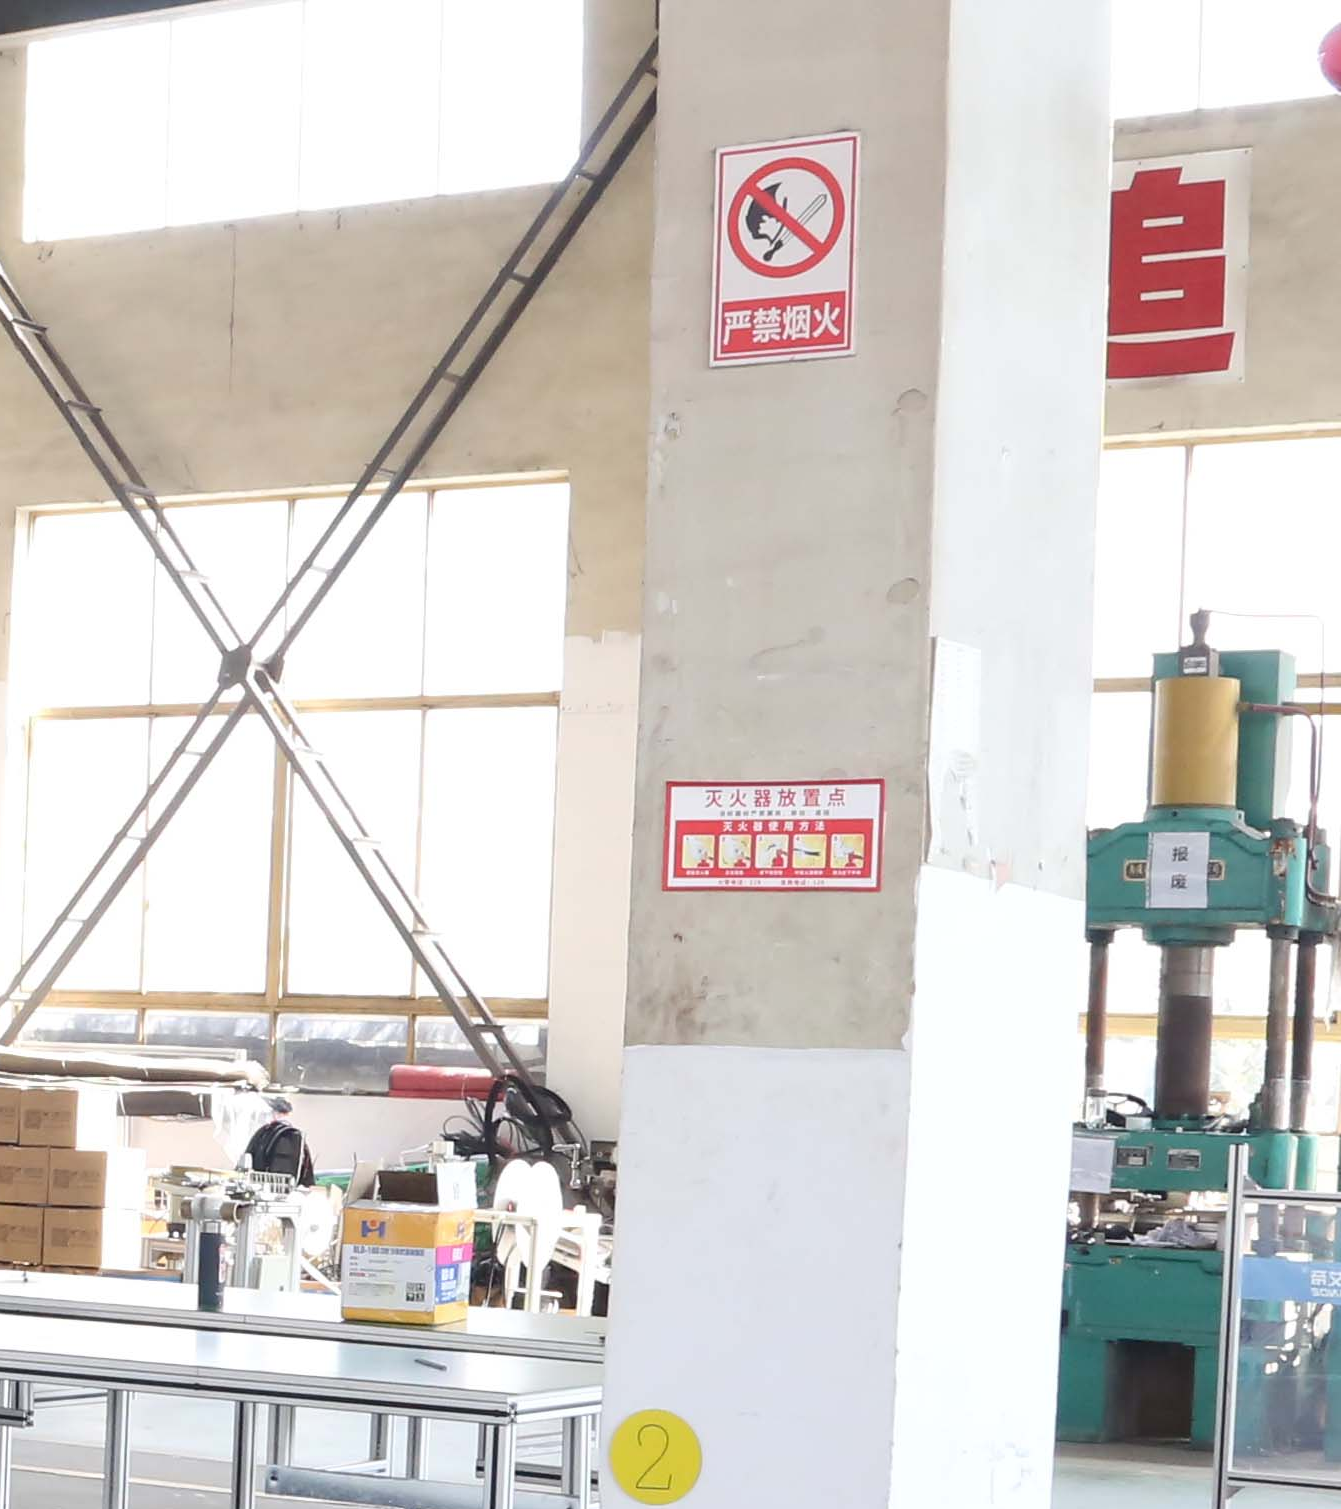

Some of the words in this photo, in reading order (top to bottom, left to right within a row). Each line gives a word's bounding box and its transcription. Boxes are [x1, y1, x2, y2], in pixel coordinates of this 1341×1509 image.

[723, 301, 841, 346] 严禁烟火
[704, 788, 846, 808] 灭火器放置点
[722, 821, 826, 832] 灭火器使用方法
[1171, 846, 1189, 890] 报废
[635, 1424, 672, 1490] 2
